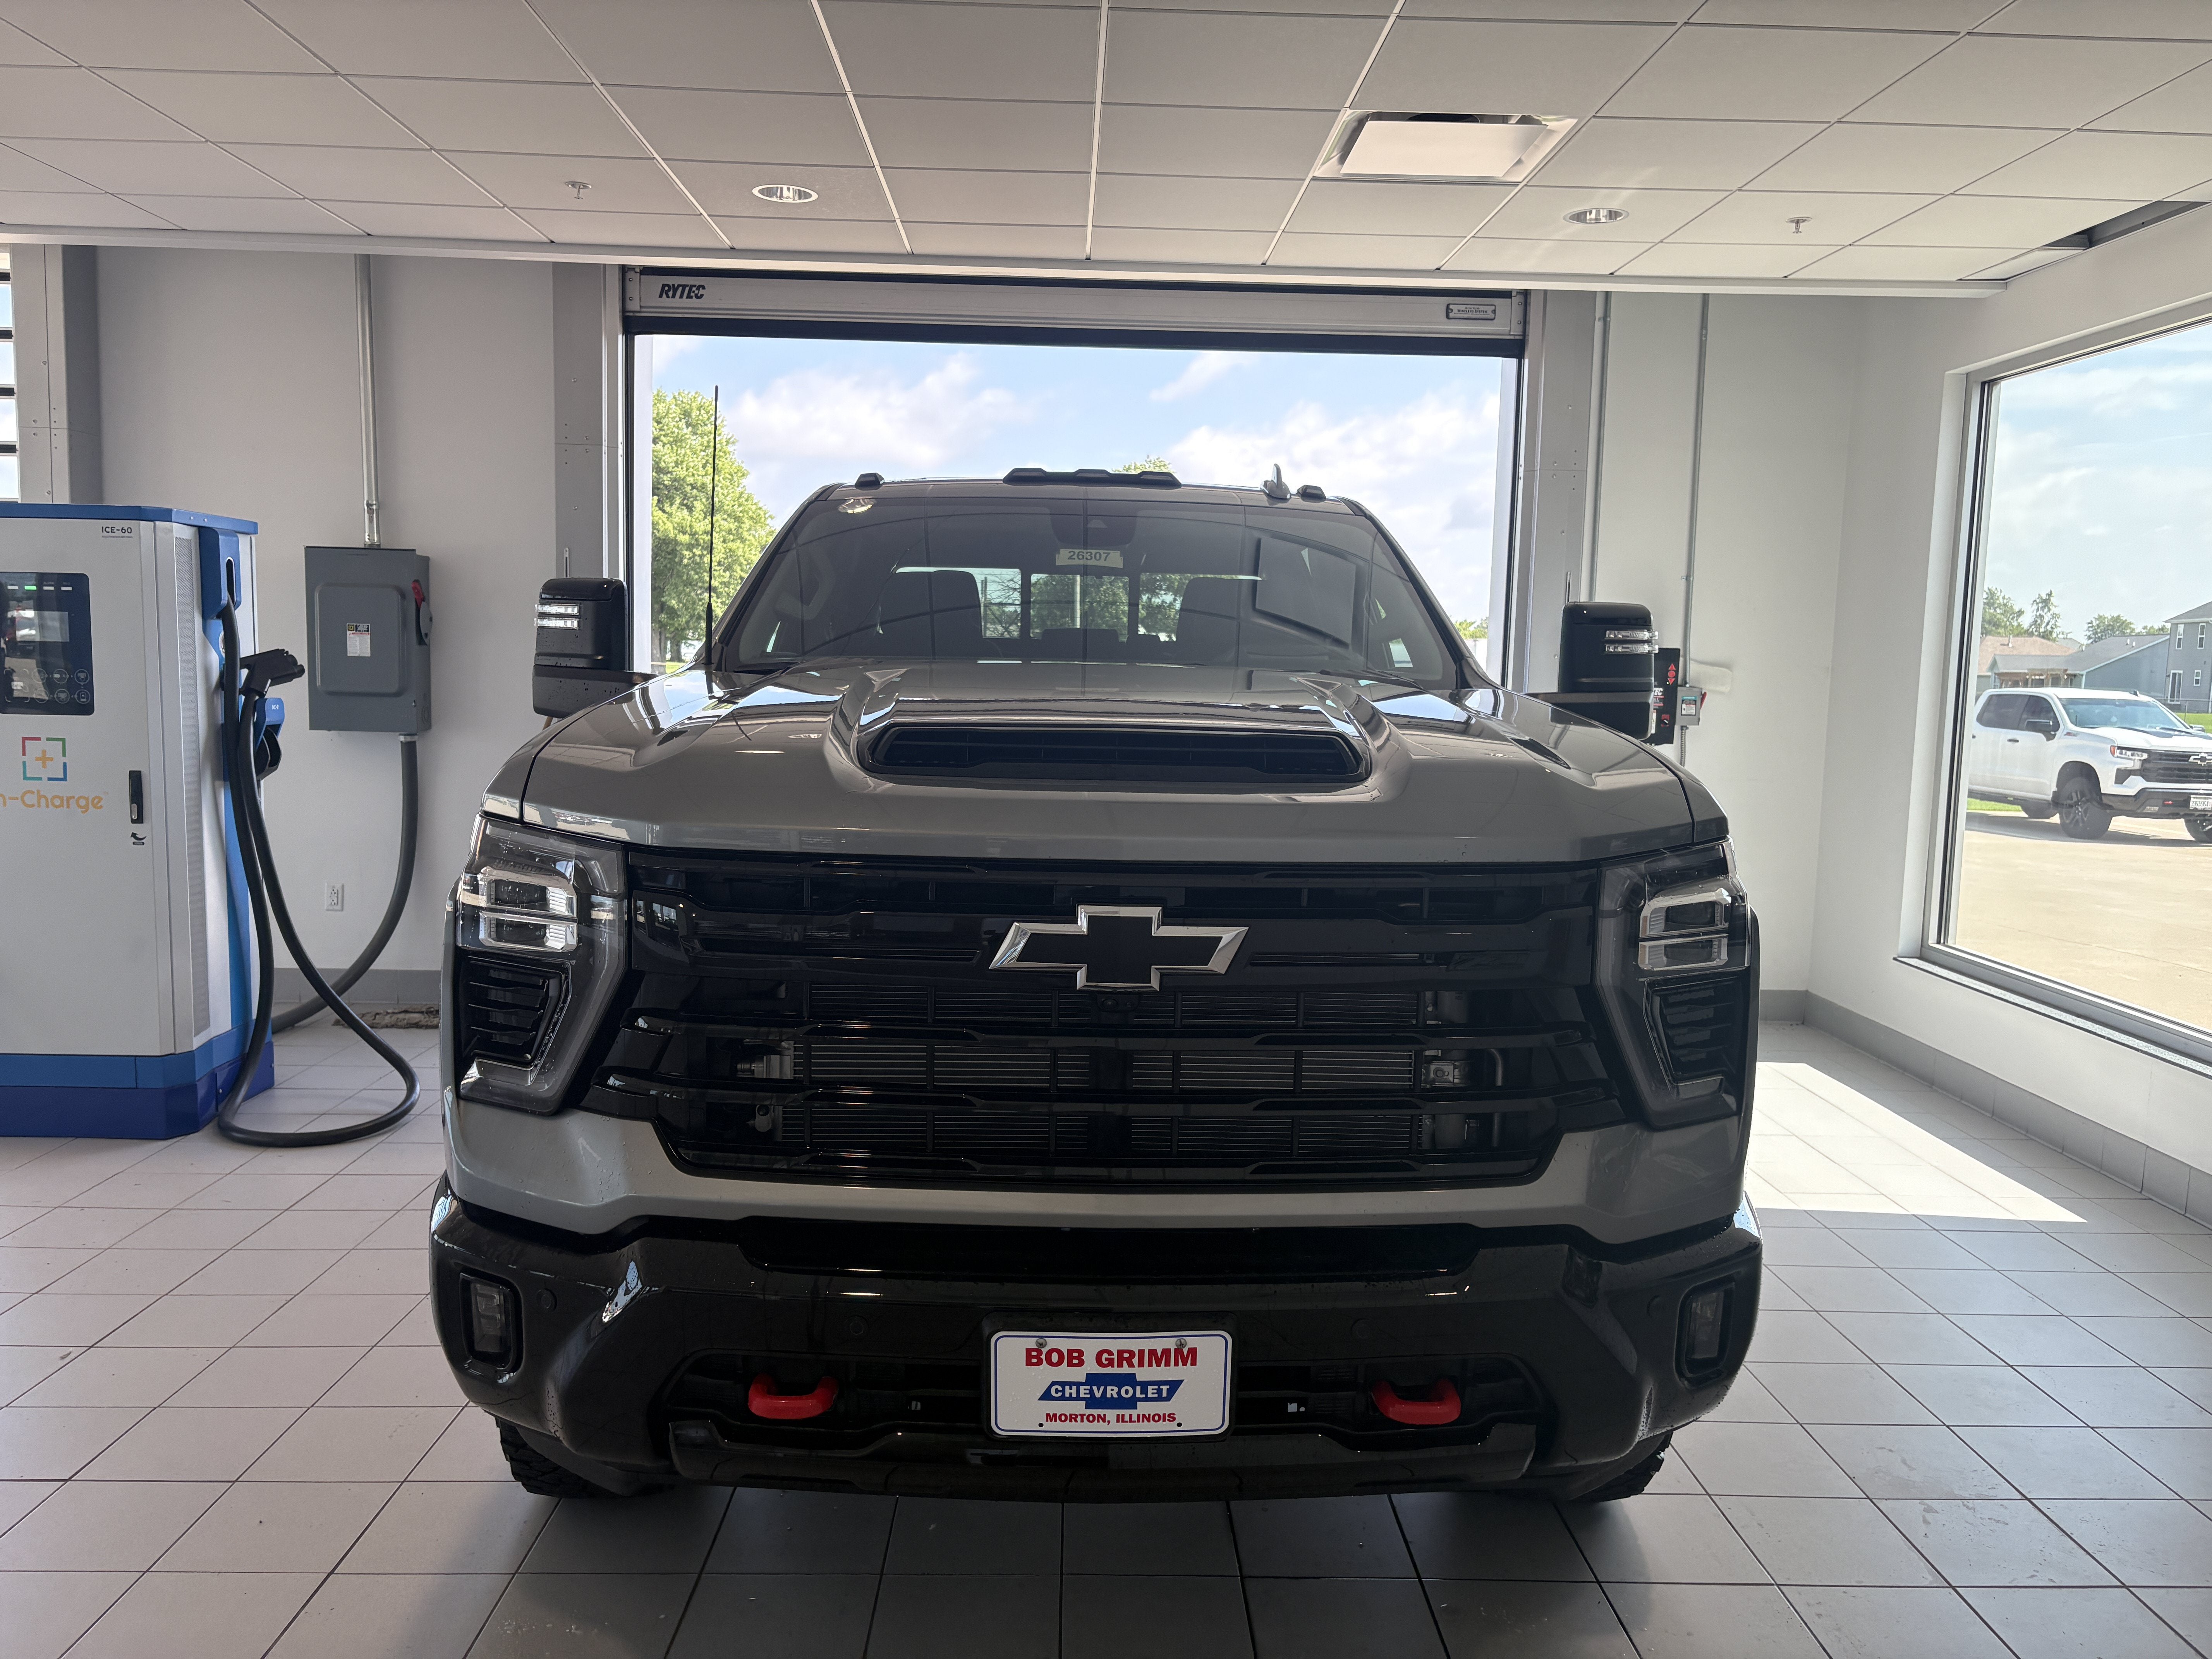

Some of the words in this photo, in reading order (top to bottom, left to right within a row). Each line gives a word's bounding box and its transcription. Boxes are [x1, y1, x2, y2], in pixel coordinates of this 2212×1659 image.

[659, 283, 706, 299] RYTEC
[1067, 550, 1111, 562] 26307
[1025, 1348, 1085, 1367] BOB
[1095, 1347, 1197, 1368] GRIMM
[1051, 1385, 1170, 1398] CHEVROLET
[1045, 1412, 1111, 1425] MORTON,
[1116, 1412, 1176, 1423] ILLINOIS
